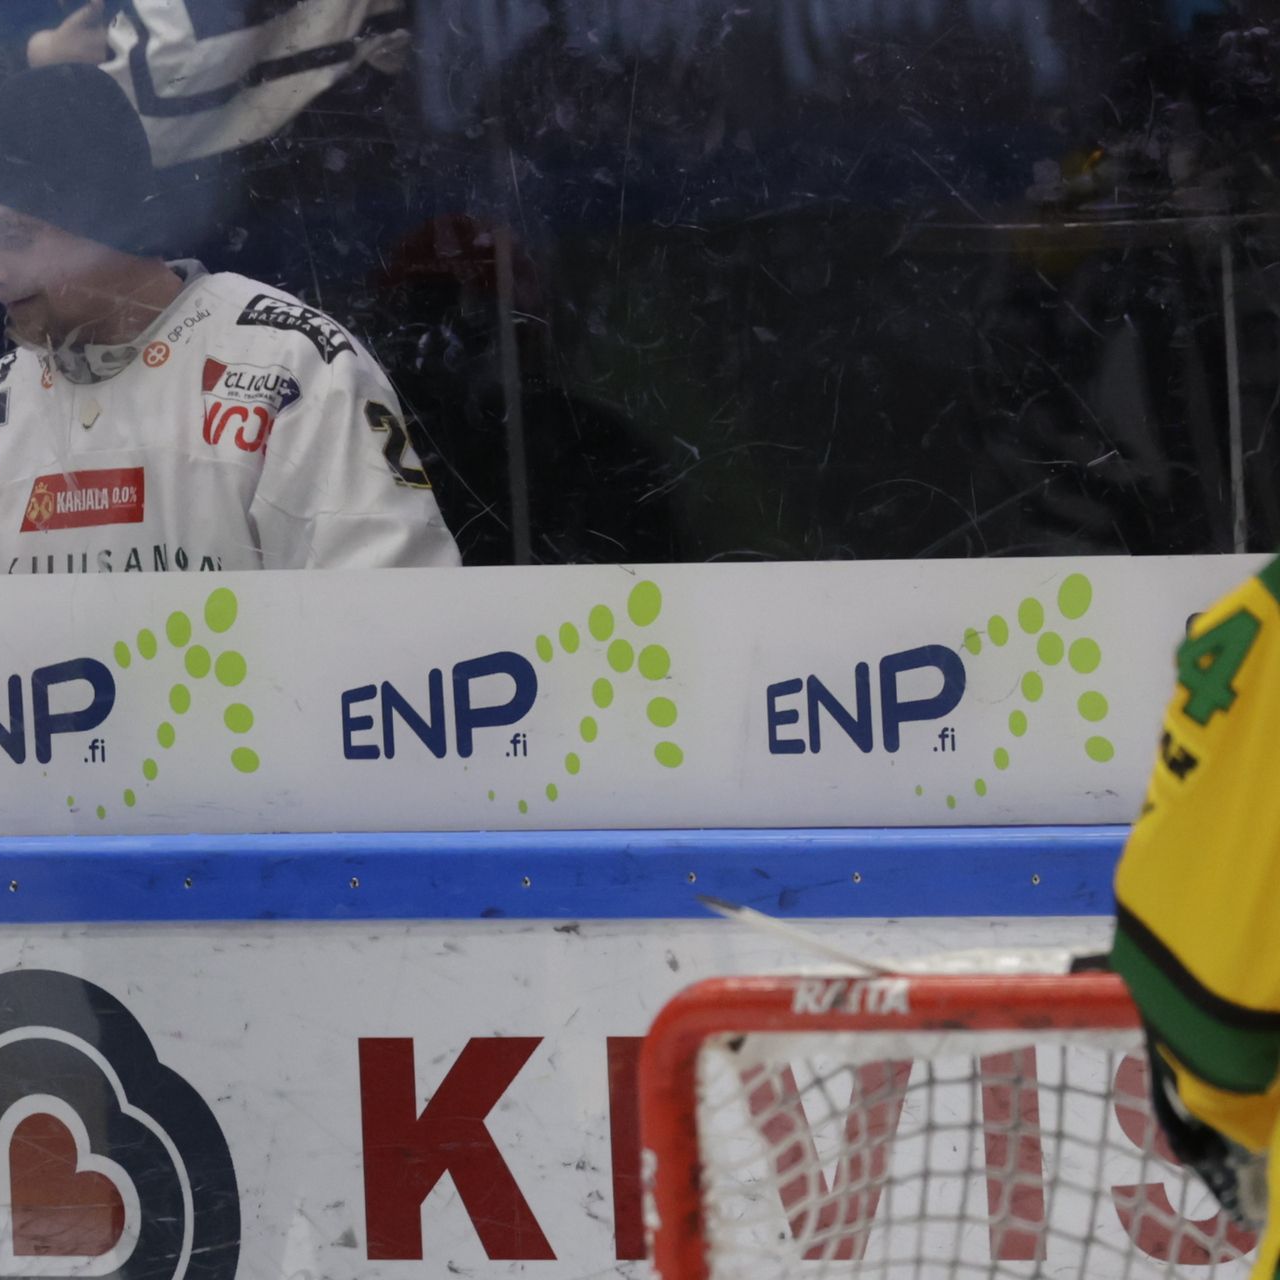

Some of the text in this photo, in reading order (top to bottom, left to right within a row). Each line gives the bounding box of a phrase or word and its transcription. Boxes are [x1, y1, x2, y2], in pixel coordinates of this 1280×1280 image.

[167, 308, 211, 344] OP Oulu
[56, 487, 109, 515] KARJALA
[341, 650, 538, 761] ENP
[767, 644, 967, 755] ENP
